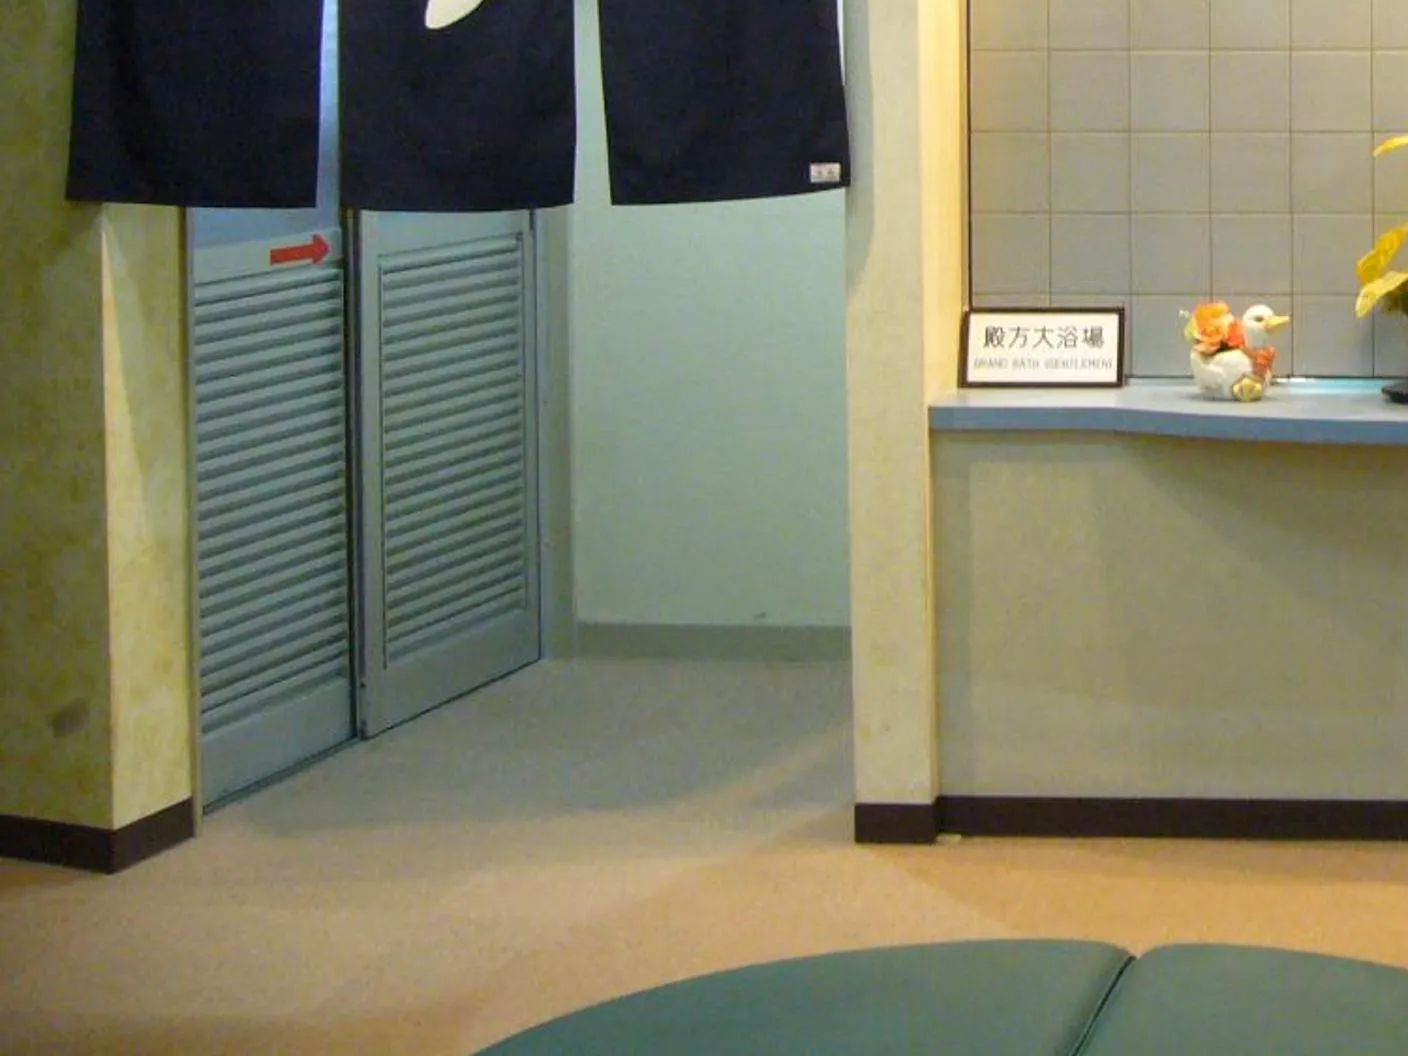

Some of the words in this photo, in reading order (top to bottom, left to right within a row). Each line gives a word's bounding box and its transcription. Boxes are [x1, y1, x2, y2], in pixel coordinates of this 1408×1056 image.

[983, 325, 1105, 350] 殿方大浴場
